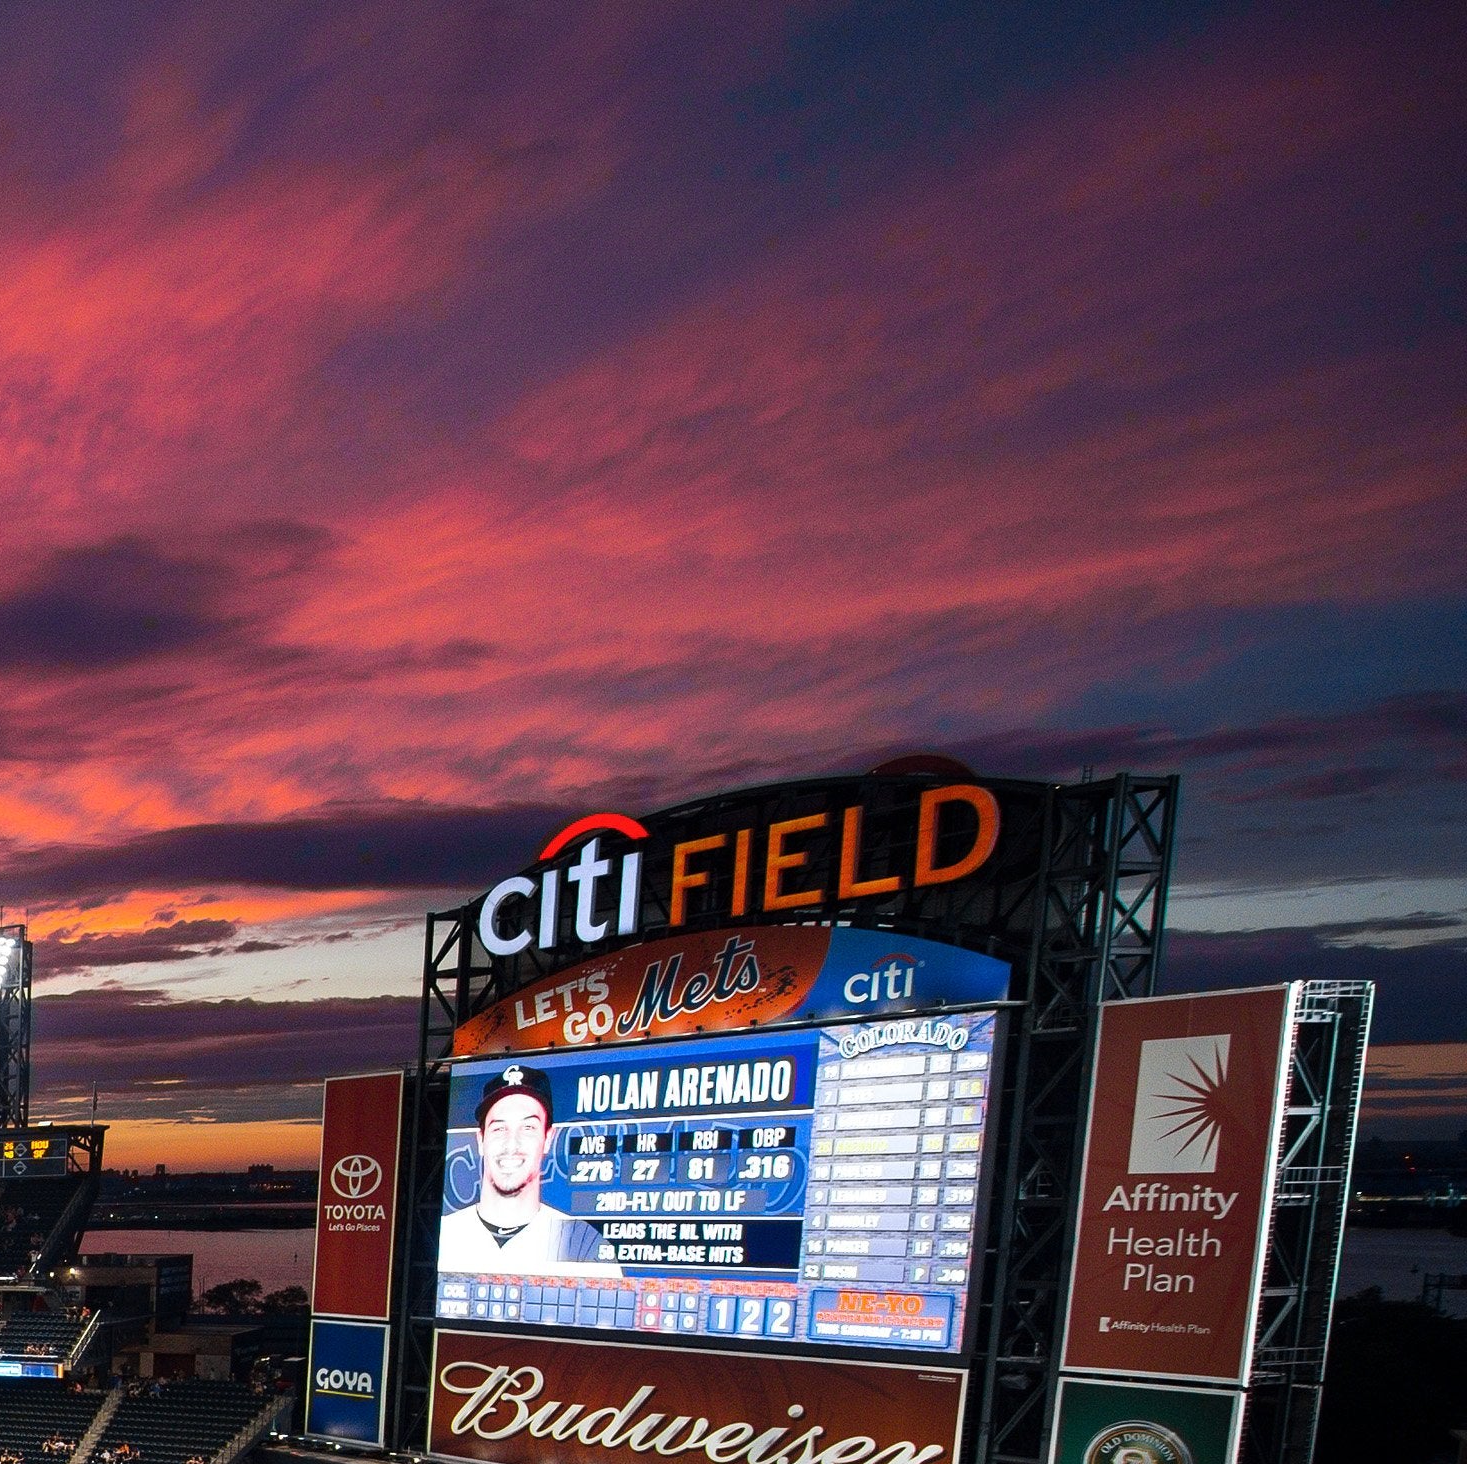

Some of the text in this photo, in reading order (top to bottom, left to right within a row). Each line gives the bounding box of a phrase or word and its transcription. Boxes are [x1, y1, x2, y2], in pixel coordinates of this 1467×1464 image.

[478, 784, 1001, 956] citi FIELD
[563, 935, 761, 1045] GO Mets
[843, 960, 912, 1005] citi
[514, 970, 611, 1030] LET'S
[839, 1020, 969, 1059] COLORADO
[576, 1071, 659, 1114] NOLAN
[663, 1059, 793, 1108] ARENADO
[579, 1127, 786, 1155] AVG HR RBI OBP
[570, 1155, 790, 1183] .276 27 81 .316
[324, 1205, 386, 1220] TOYOTA
[596, 1191, 746, 1212] 2ND-FLY OUT TO LF
[1102, 1182, 1239, 1220] Affinity
[346, 1223, 355, 1232] Go
[356, 1223, 380, 1232] Places
[602, 1223, 743, 1241] LEADS THE NL WITH
[618, 1244, 743, 1263] EXTRA-BASE HITS
[1107, 1227, 1222, 1258] Health
[1123, 1263, 1195, 1293] Plan
[716, 1299, 790, 1334] 1 2 2
[838, 1292, 924, 1314] NE-YO
[1111, 1320, 1211, 1335] Affinity Health Plan
[316, 1367, 372, 1393] GOYA
[1100, 1432, 1176, 1461] OLD DOMINION
